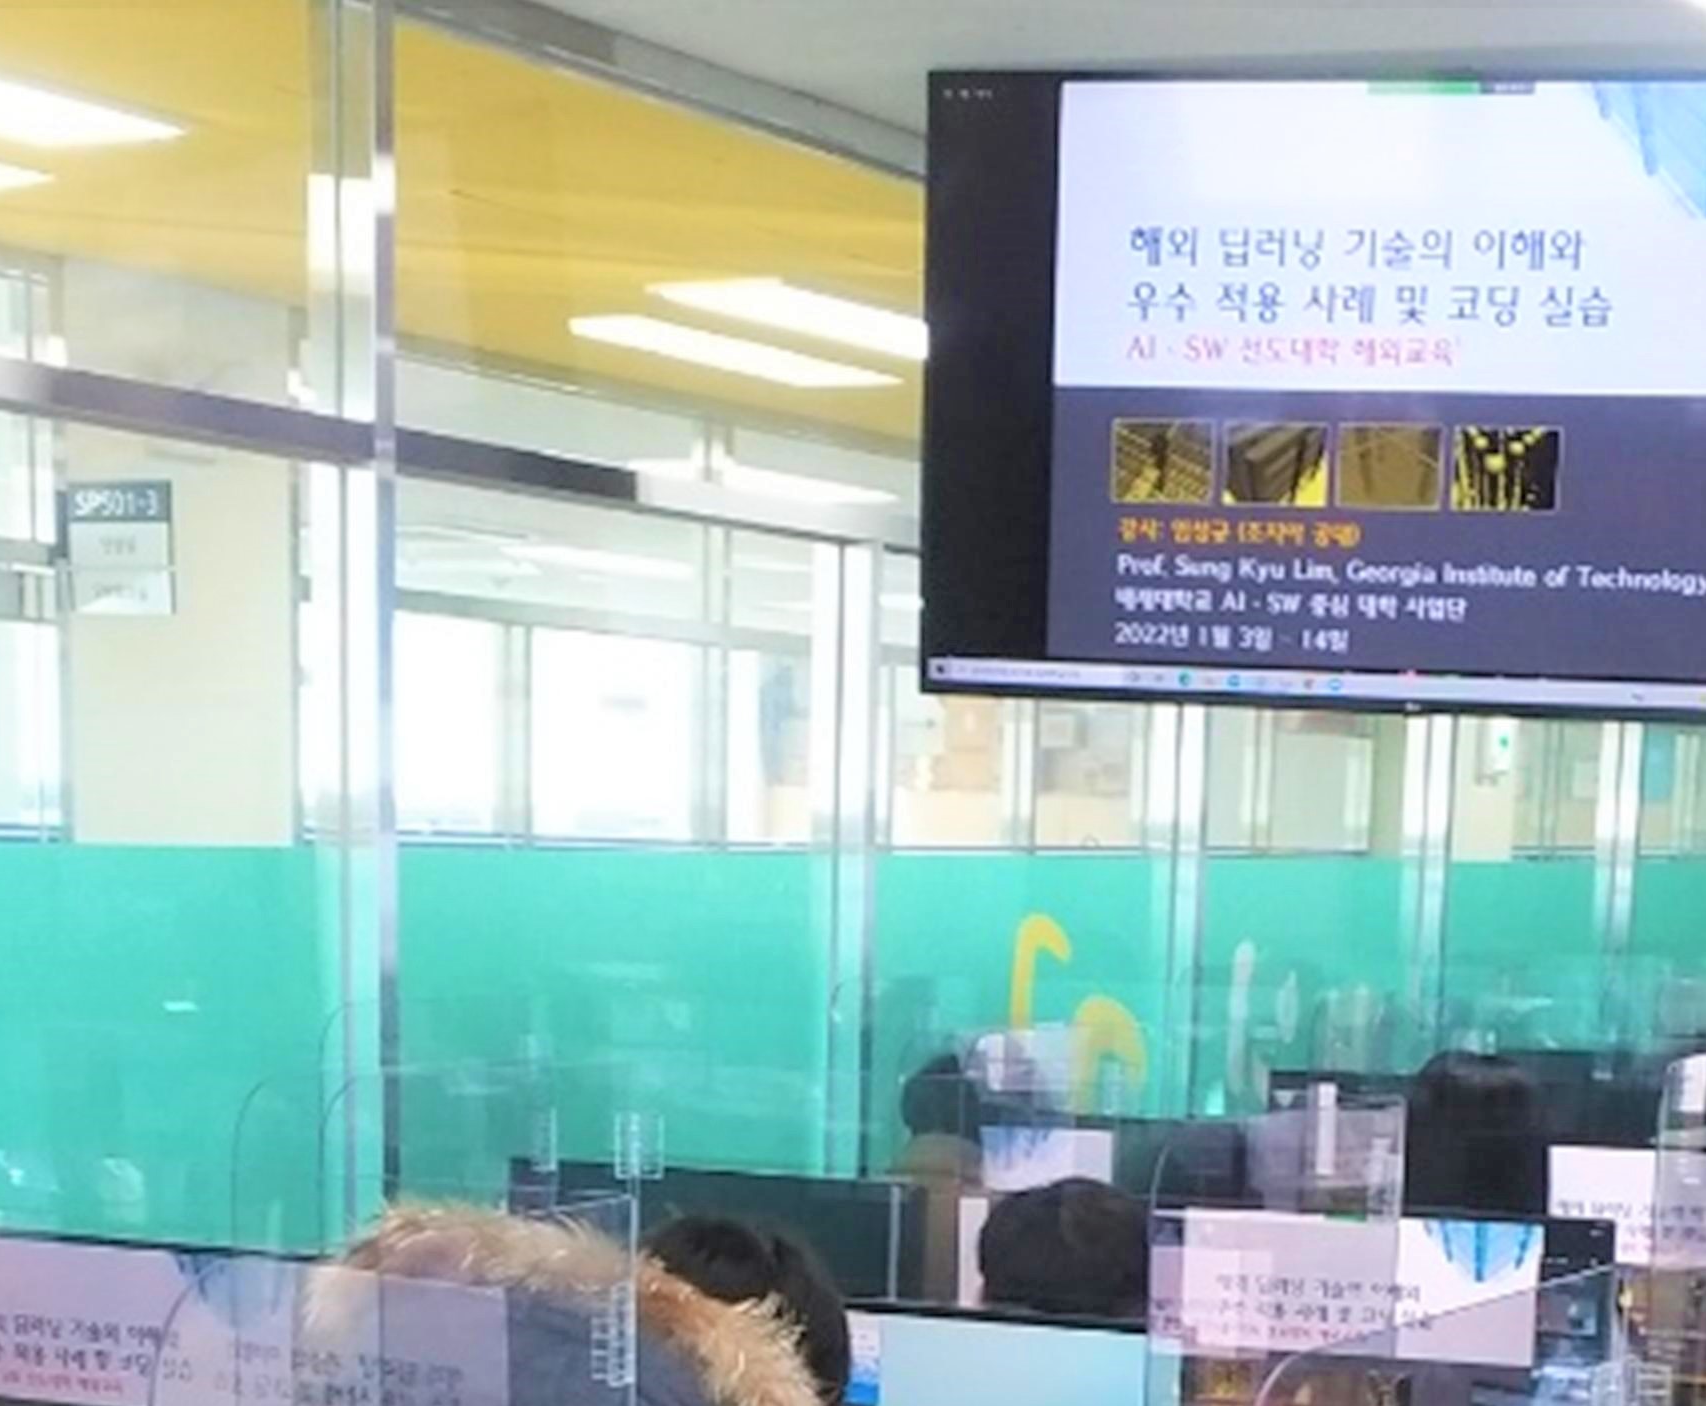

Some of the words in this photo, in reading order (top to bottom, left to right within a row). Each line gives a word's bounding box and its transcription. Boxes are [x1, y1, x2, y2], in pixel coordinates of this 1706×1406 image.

[1130, 226, 1199, 268] 해외
[1218, 227, 1326, 271] 딥러닝
[1343, 229, 1454, 271] 기술의
[1472, 229, 1589, 272] 이해와
[1126, 281, 1197, 323] 우수
[1216, 281, 1285, 324] 적용
[1303, 283, 1377, 326] 사례
[1393, 284, 1429, 326] 및
[1447, 285, 1522, 327] 코딩
[1539, 286, 1614, 328] 실습
[1126, 336, 1157, 361] AI
[1183, 336, 1225, 362] SW
[1116, 553, 1168, 578] Prof.
[1174, 554, 1233, 583] Sung
[1238, 557, 1286, 584] Kyu
[1292, 557, 1340, 584] Lim,
[1345, 558, 1437, 588] Georgia
[1443, 562, 1539, 588] Institute
[1544, 564, 1571, 589] of
[1220, 589, 1247, 611] AI
[1266, 591, 1302, 614] SW
[1113, 621, 1191, 648] 2022년
